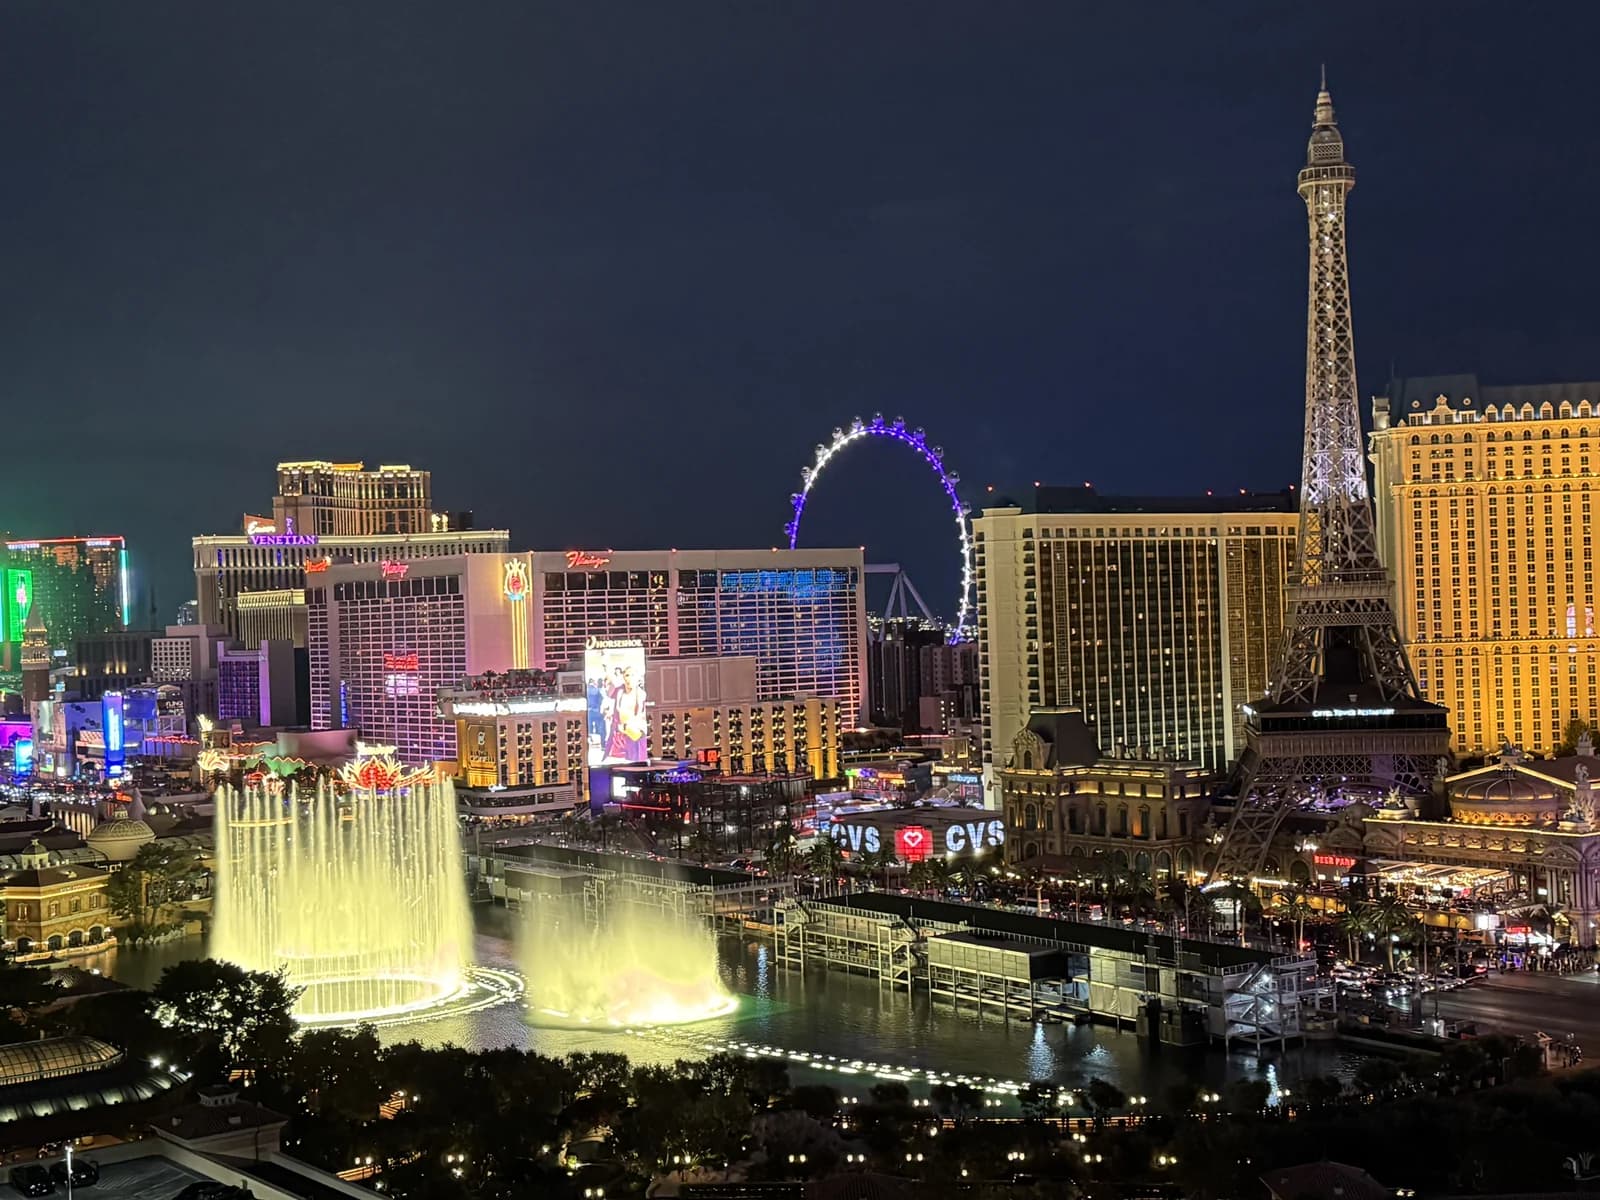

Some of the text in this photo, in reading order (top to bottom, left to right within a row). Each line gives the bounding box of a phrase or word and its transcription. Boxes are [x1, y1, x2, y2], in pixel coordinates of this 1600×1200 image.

[250, 535, 316, 545] VENETIAN
[831, 823, 880, 853] CVS
[945, 820, 1005, 852] CVS
[1314, 855, 1334, 865] BEER
